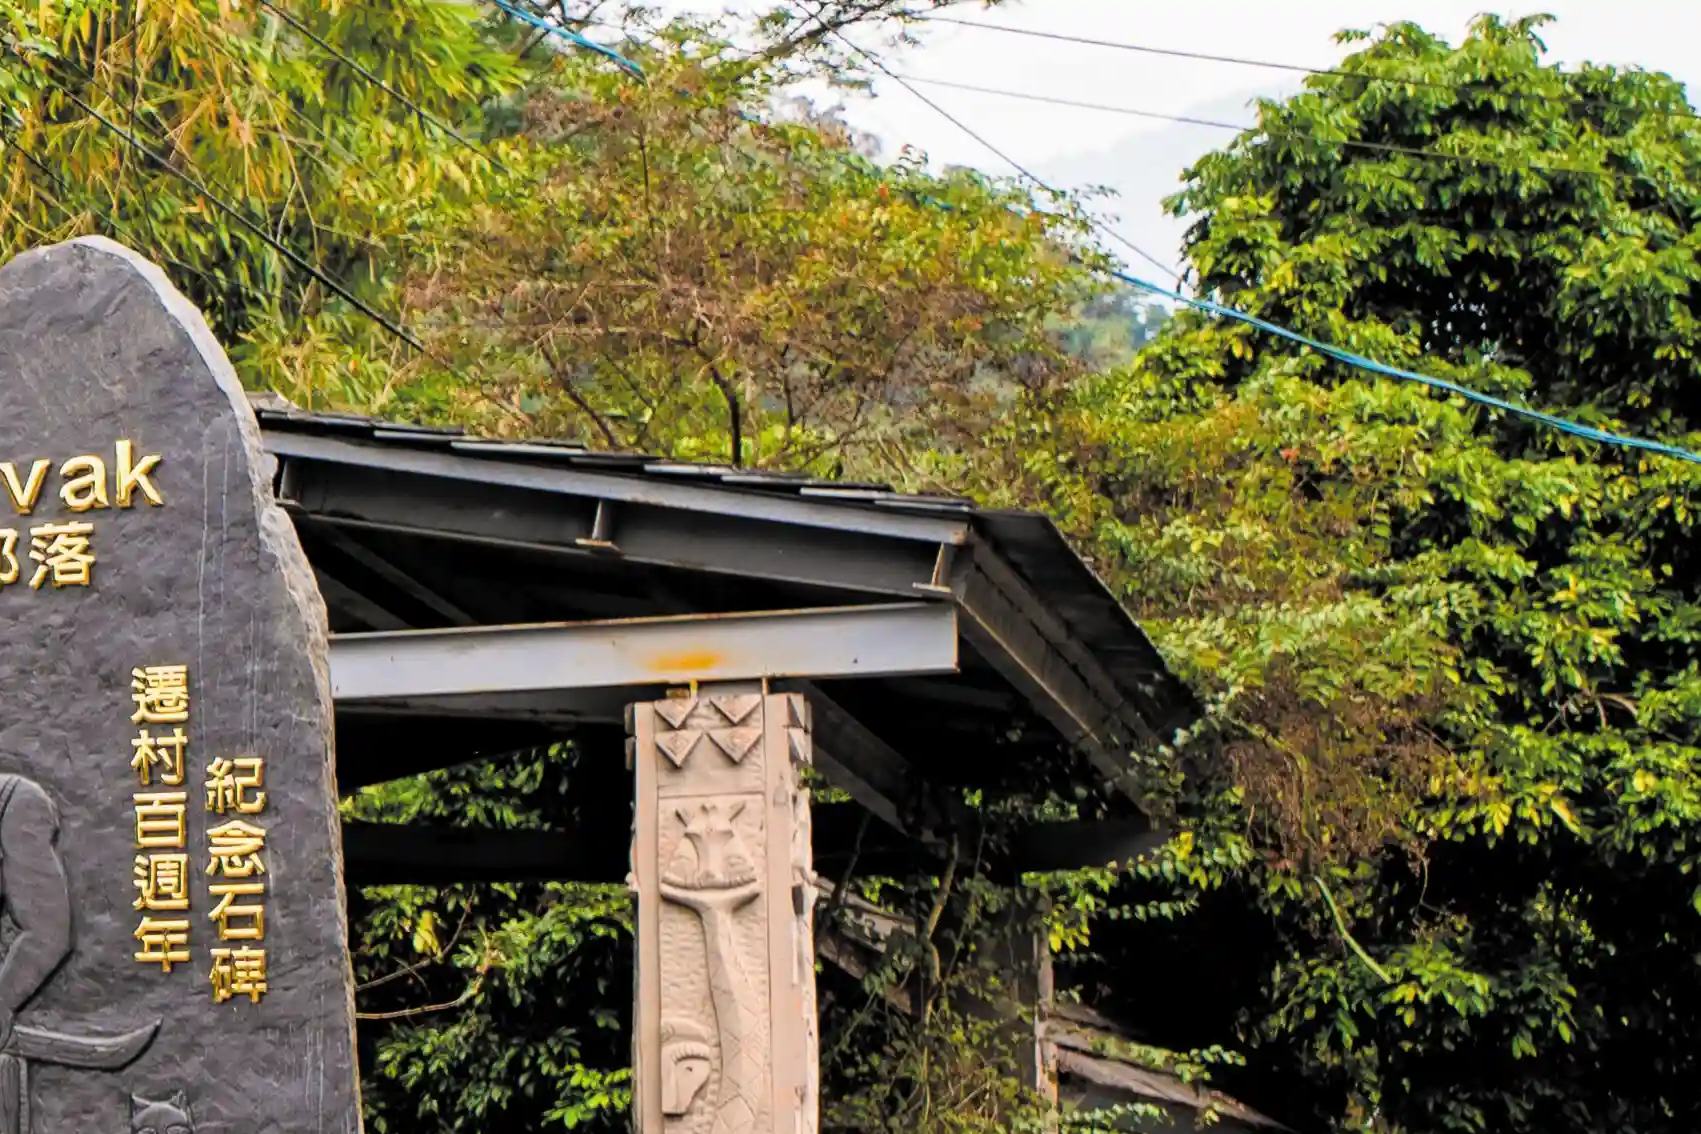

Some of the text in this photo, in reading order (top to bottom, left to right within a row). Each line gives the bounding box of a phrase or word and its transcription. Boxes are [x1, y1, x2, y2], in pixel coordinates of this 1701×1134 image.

[131, 664, 192, 973] 遷村百週年
[205, 756, 269, 1004] 紀念石碑
